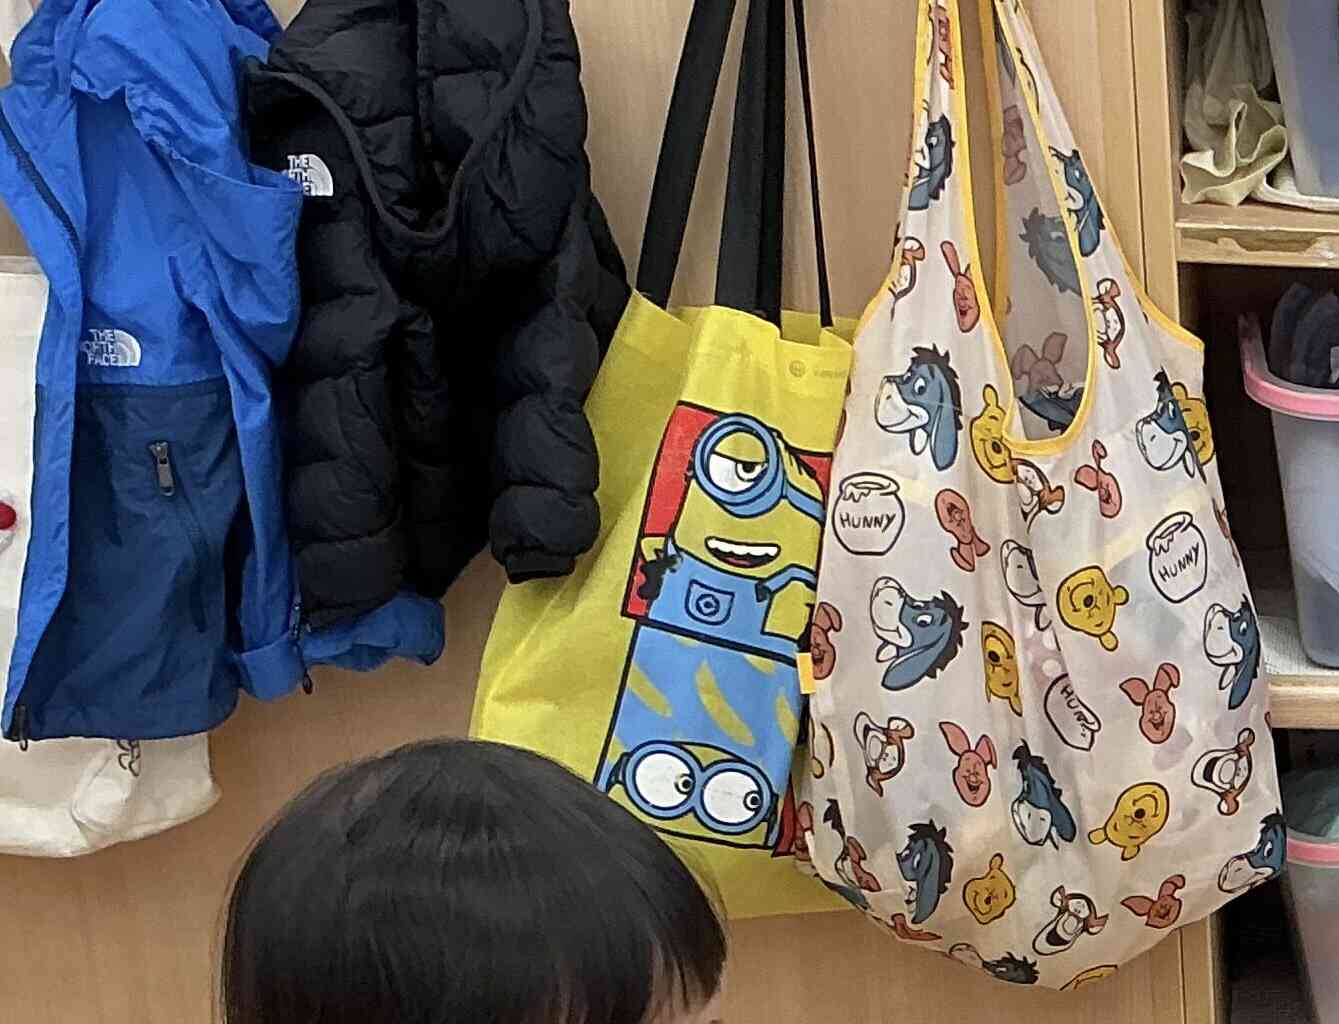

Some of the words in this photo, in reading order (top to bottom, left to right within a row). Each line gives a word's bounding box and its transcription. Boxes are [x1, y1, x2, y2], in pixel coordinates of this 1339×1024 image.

[287, 154, 310, 168] THE
[89, 328, 114, 341] THE
[839, 512, 896, 533] HUNNY
[1158, 541, 1199, 583] HUNNY
